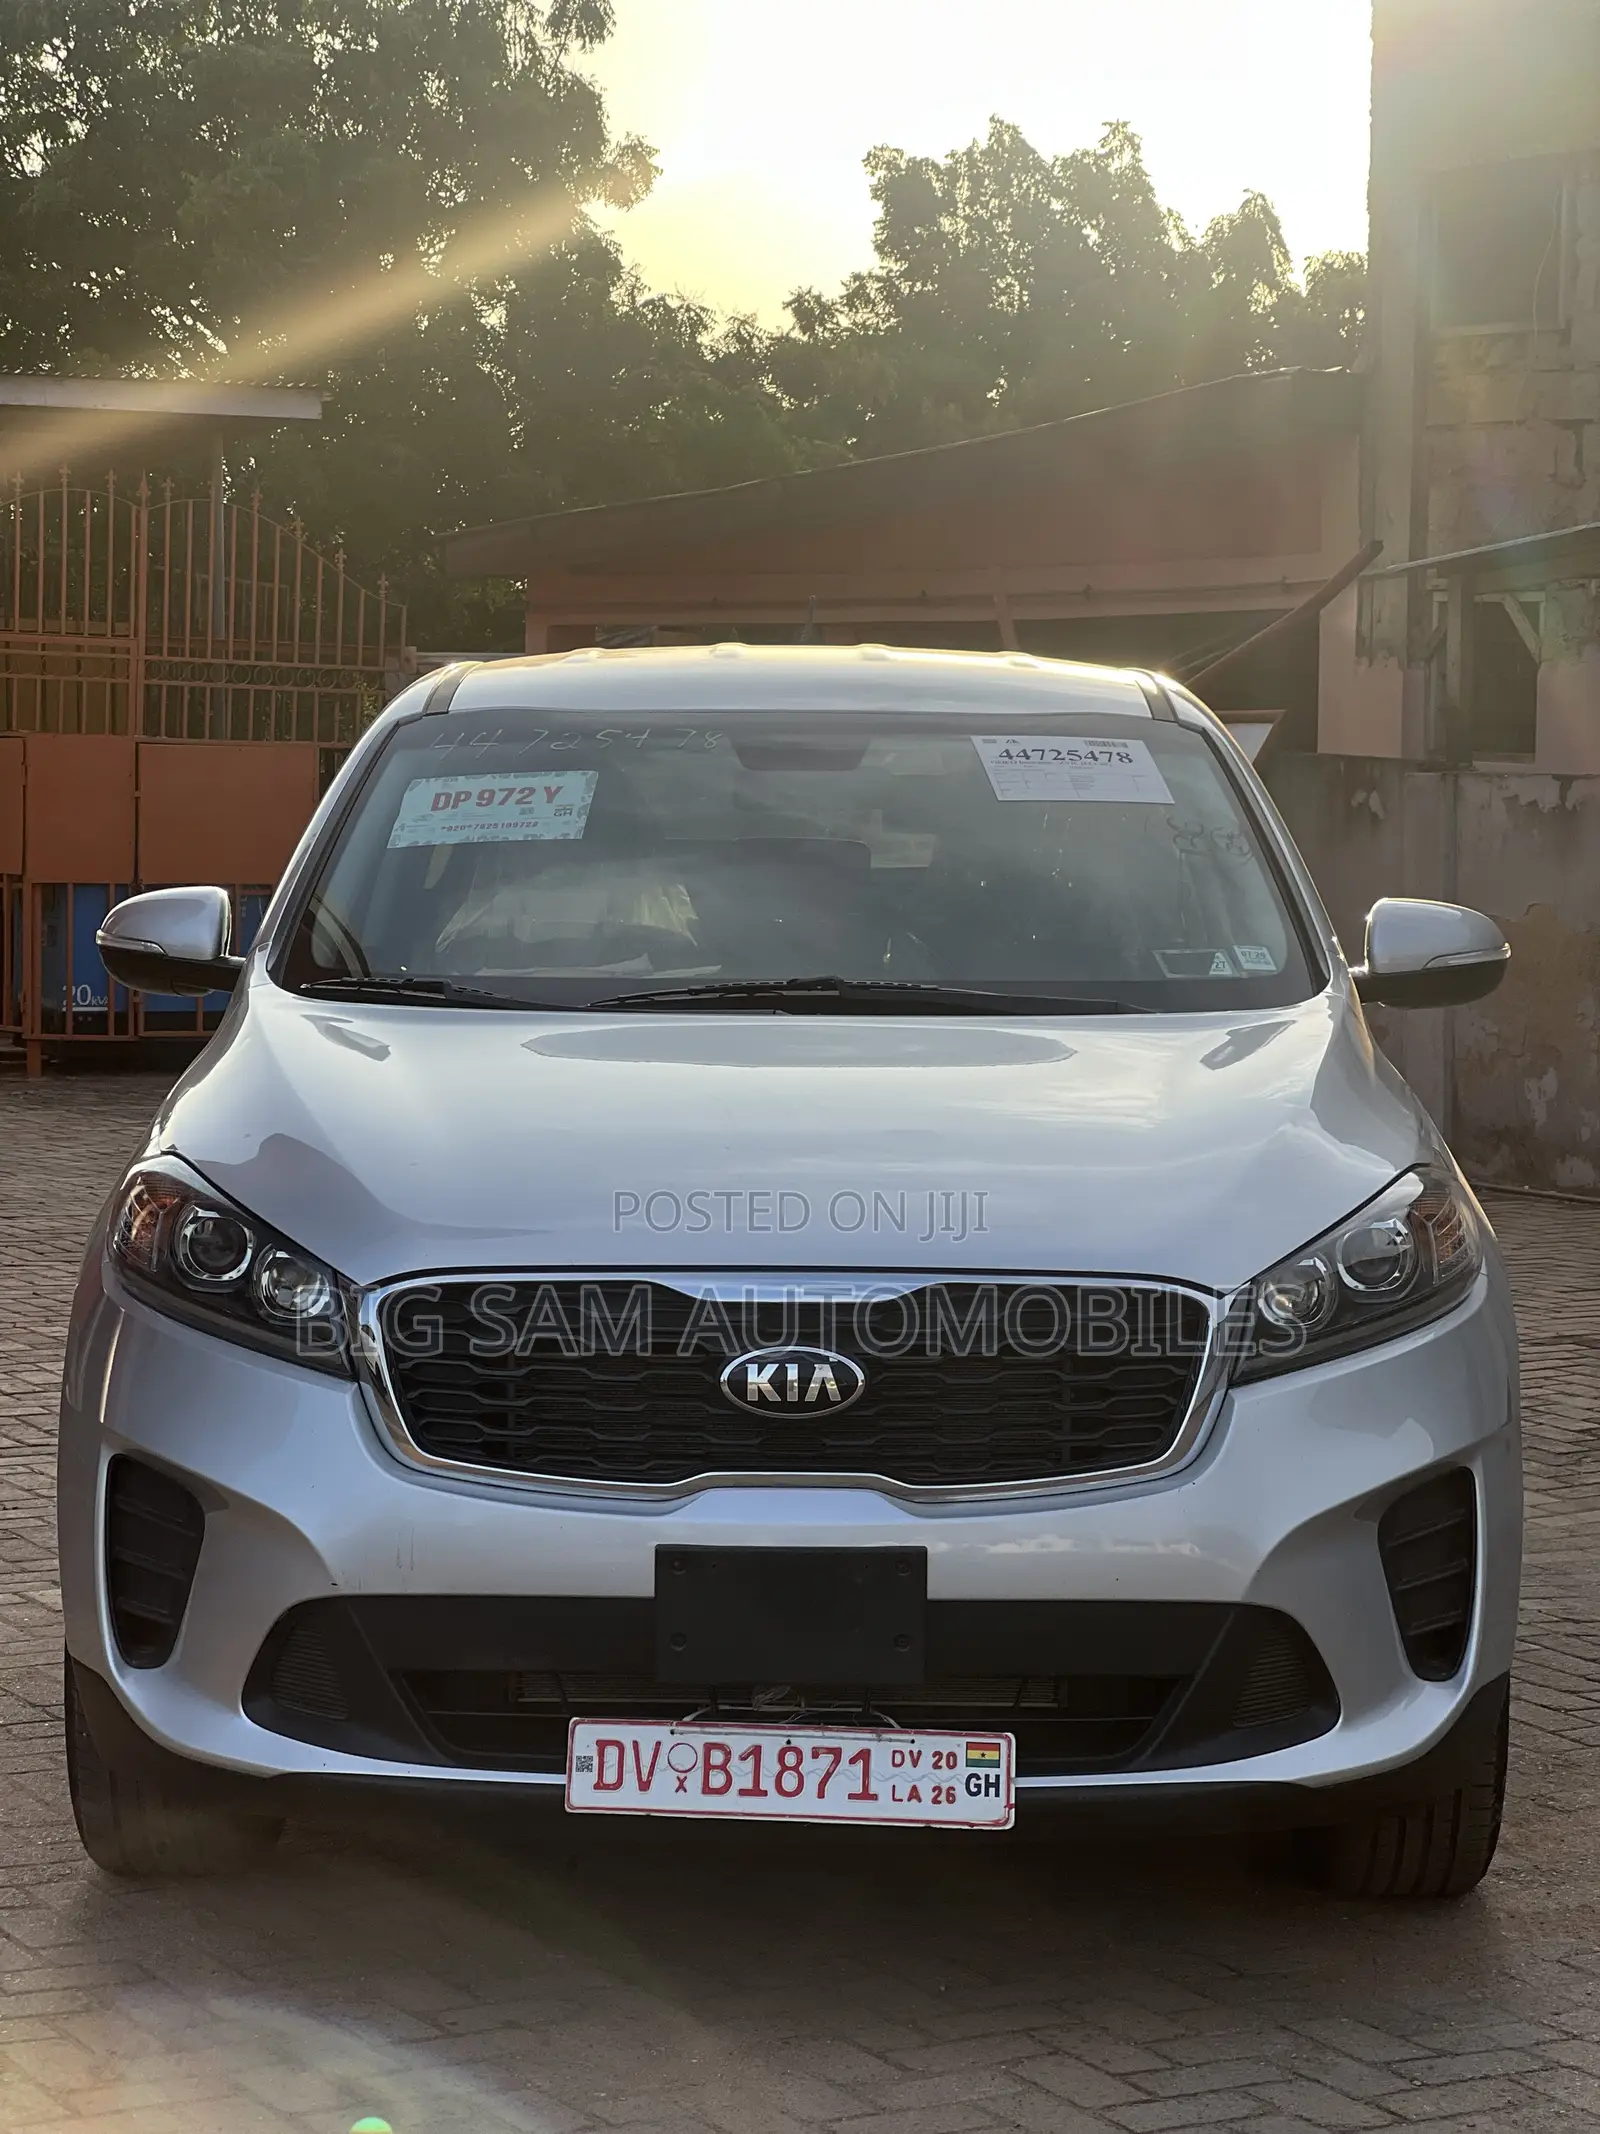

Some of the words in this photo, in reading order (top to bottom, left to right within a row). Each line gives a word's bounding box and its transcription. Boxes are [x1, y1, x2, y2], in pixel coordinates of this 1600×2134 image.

[998, 748, 1134, 764] 44725478
[430, 791, 473, 812] DP
[475, 785, 537, 807] 972
[542, 784, 565, 804] Y
[745, 1362, 842, 1402] KIA
[592, 1738, 663, 1793] DV
[701, 1741, 880, 1801] B1871
[891, 1749, 923, 1769] DV
[932, 1750, 958, 1770] 20
[891, 1784, 922, 1803] LA
[931, 1785, 957, 1804] 26
[964, 1771, 1000, 1798] GH
